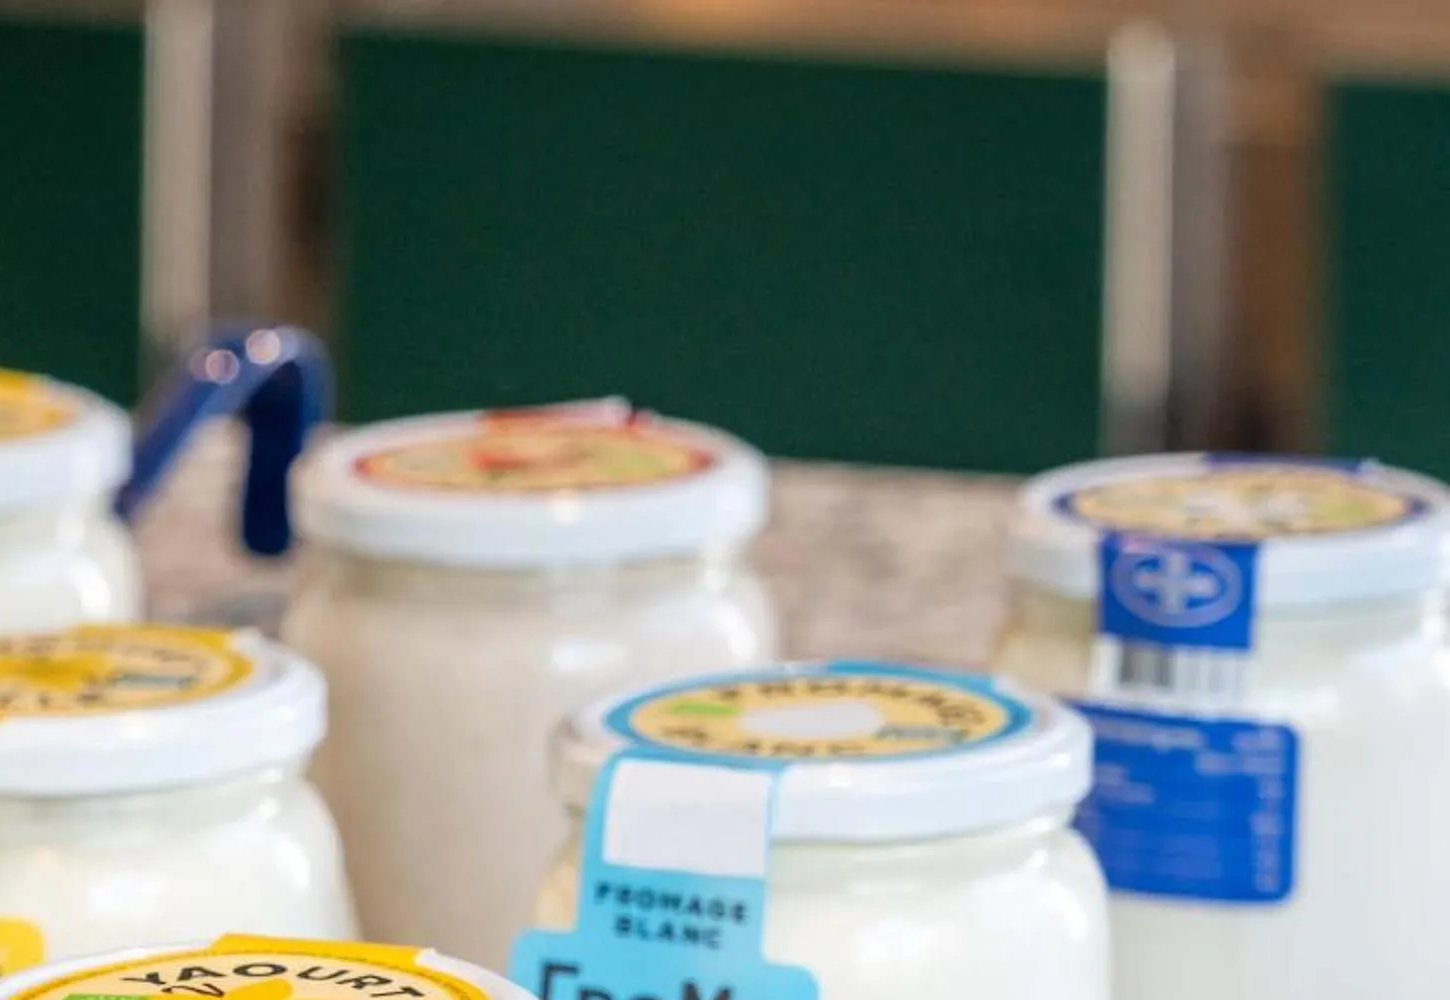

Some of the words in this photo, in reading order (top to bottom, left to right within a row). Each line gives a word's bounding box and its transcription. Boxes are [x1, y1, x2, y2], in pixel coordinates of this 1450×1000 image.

[595, 881, 748, 922] FROMAGE
[614, 914, 722, 949] BLANC
[121, 962, 425, 998] YAOURT
